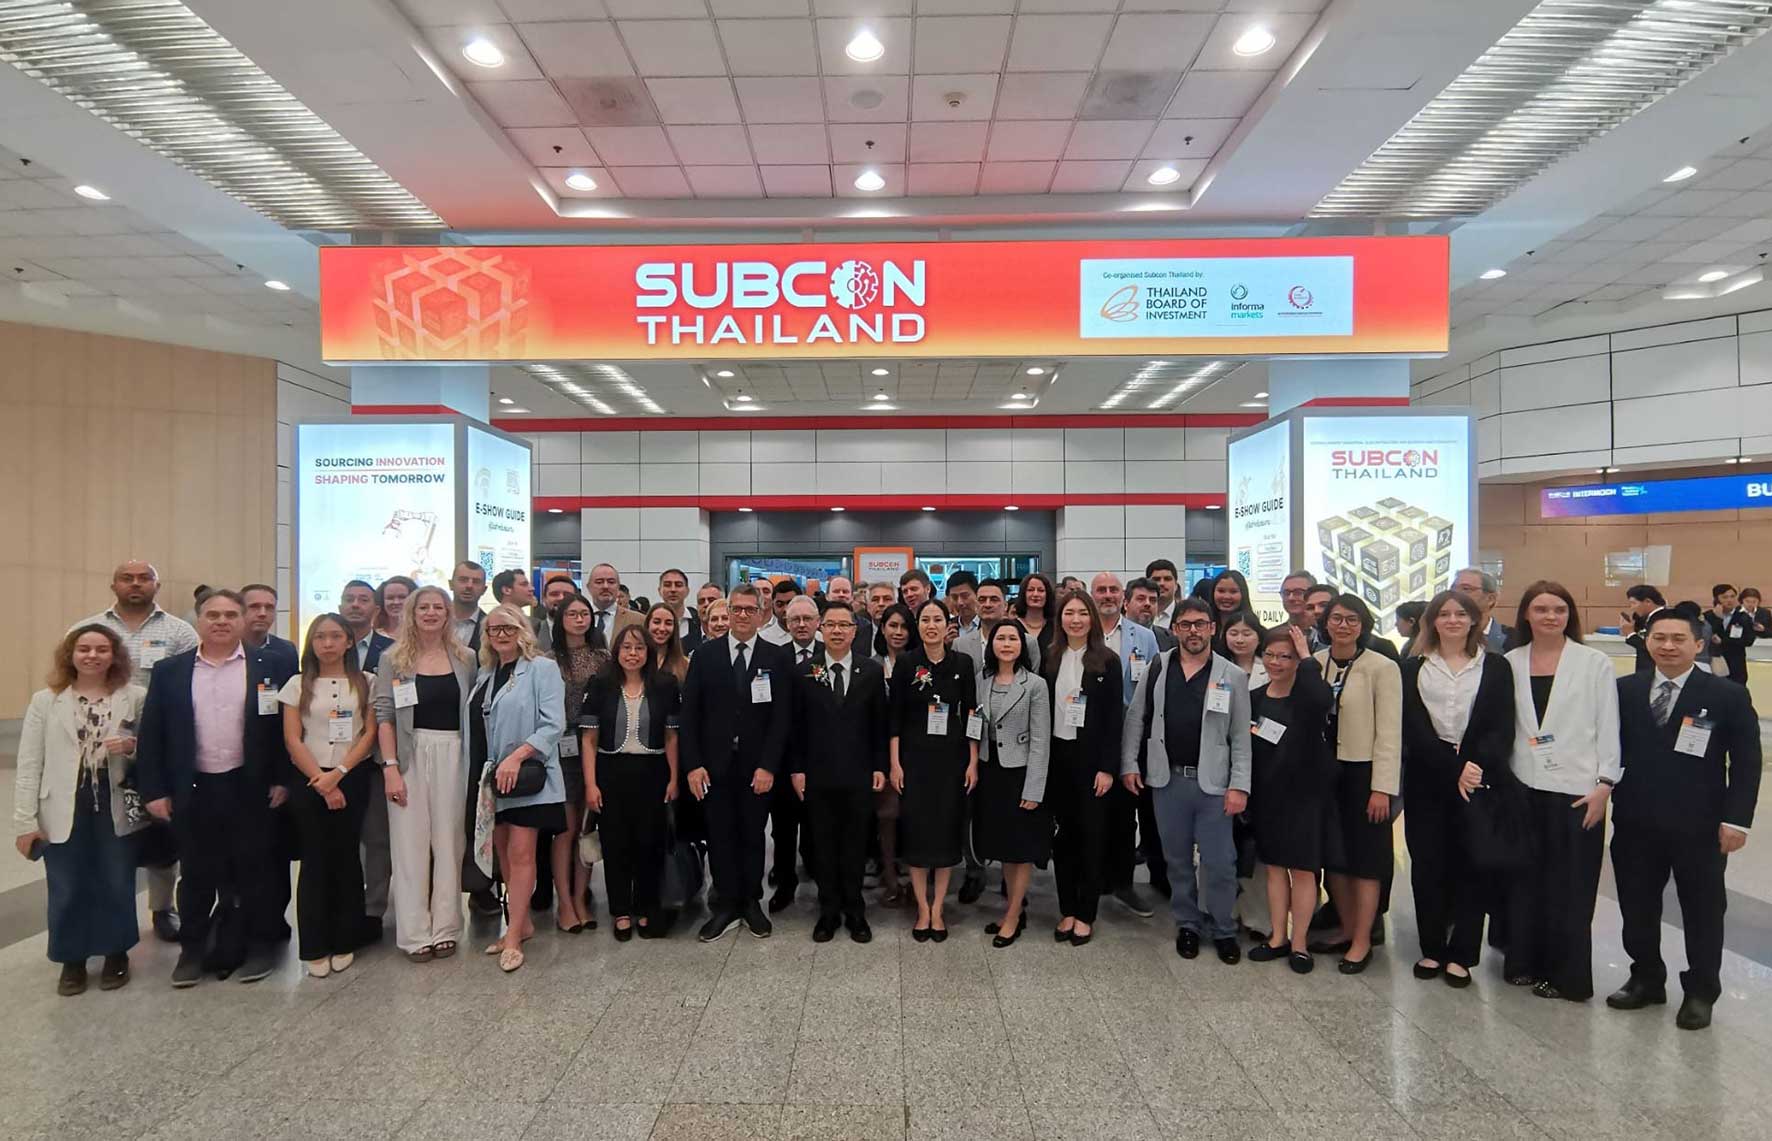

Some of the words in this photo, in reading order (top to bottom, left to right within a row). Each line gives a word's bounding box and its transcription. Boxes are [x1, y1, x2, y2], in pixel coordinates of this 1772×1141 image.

[635, 260, 926, 310] SUBCON
[1146, 287, 1207, 298] THAILAND
[1146, 299, 1187, 309] BOARD
[1190, 299, 1207, 309] OF
[1231, 303, 1264, 311] informa
[1146, 310, 1207, 320] INVESTMENT
[1231, 311, 1264, 319] markets
[636, 313, 925, 345] THAILAND
[315, 458, 374, 467] SOURCING
[375, 457, 445, 466] INNOVATION
[1331, 449, 1438, 467] SUBCON
[315, 475, 369, 484] SHAPING
[371, 474, 445, 484] TOMORROW
[1332, 468, 1438, 479] THAILAND
[475, 502, 505, 518] E-SHOW
[505, 508, 525, 522] GUIDE
[1235, 502, 1261, 518] E-SHOW
[1261, 497, 1284, 512] GUIDE
[1263, 611, 1284, 623] DAILY
